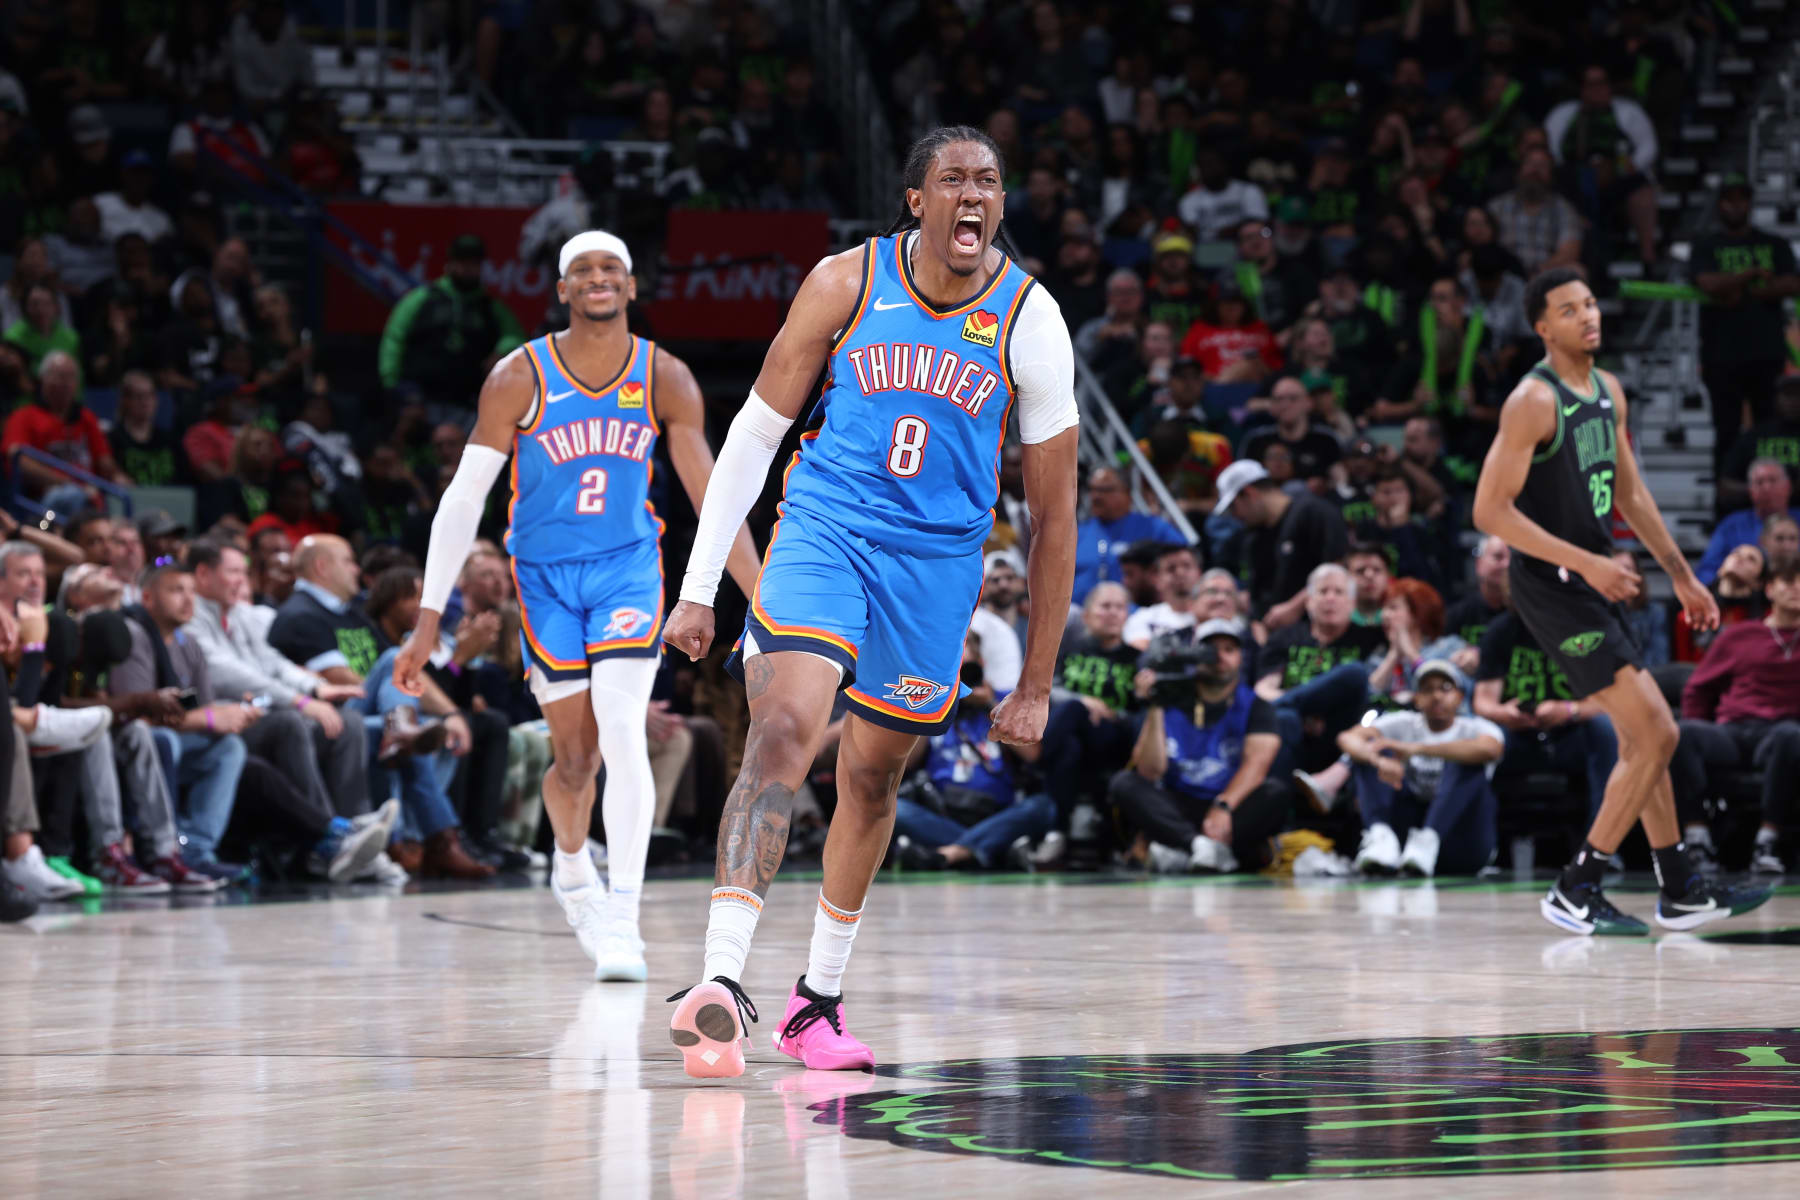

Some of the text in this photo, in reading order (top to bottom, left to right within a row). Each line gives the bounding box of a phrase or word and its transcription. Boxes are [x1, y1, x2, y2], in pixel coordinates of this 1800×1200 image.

[848, 343, 999, 418] THUNDER
[537, 418, 653, 465] THUNDER
[887, 415, 930, 478] 8
[576, 467, 608, 514] 2
[1588, 469, 1614, 518] 25
